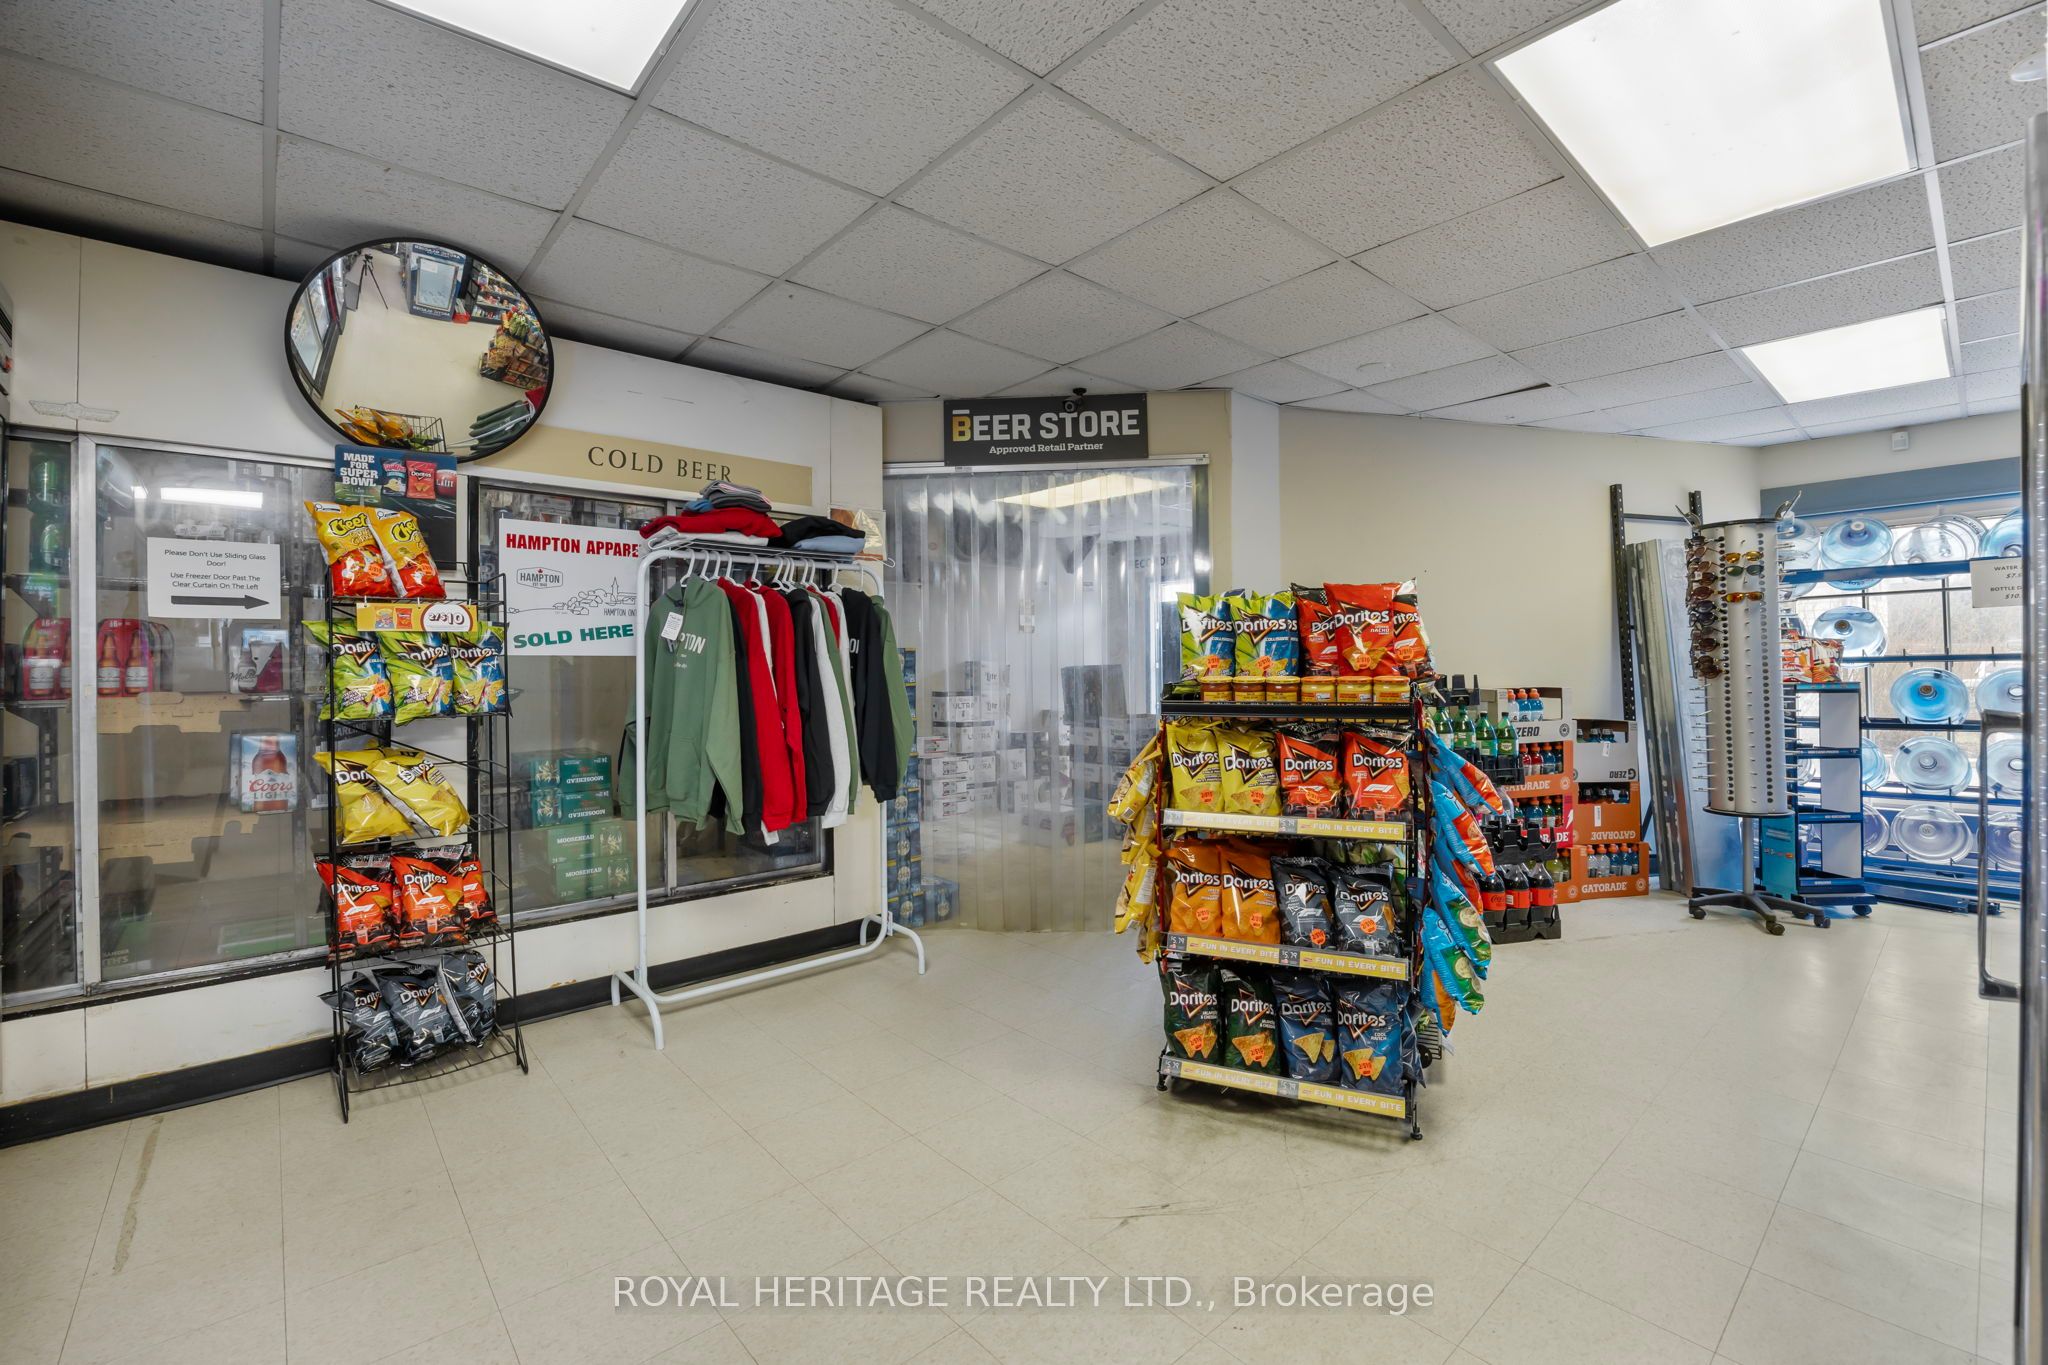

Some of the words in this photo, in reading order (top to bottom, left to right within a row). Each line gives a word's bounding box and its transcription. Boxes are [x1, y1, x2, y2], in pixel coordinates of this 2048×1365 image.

[952, 413, 1031, 441] BEER
[1039, 409, 1140, 439] STORE
[989, 444, 1036, 454] Approved
[1038, 442, 1066, 452] Retail
[1068, 442, 1104, 451] Partner
[343, 452, 375, 464] MADE
[588, 446, 663, 474] COLD
[677, 458, 732, 483] BEER
[350, 461, 369, 470] FOR
[340, 467, 378, 479] SUPER
[342, 476, 377, 487] BOWL
[328, 513, 368, 537] Cheet
[506, 533, 581, 554] HAMPTON
[586, 540, 641, 558] APPARE
[164, 549, 188, 557] Please
[189, 550, 208, 558] Don't
[224, 552, 247, 560] Sliding
[185, 572, 212, 580] Freezer
[519, 572, 560, 584] HAMPTON
[192, 581, 218, 589] Curtain
[604, 608, 627, 617] HAMPTON
[1334, 609, 1390, 628] Doritos
[1393, 612, 1420, 625] ritos
[428, 613, 465, 626] 2/$10
[1234, 618, 1287, 634] Doritos
[513, 630, 573, 649] SOLD
[580, 624, 634, 642] HERE
[1516, 726, 1540, 737] ZERO
[1173, 752, 1219, 767] Doritos
[1224, 756, 1274, 772] Doritos
[1285, 758, 1334, 771] Doritos
[1353, 753, 1403, 768] Doritos
[249, 779, 293, 793] Coors
[566, 775, 604, 784] MOOSEHEAD
[254, 791, 289, 800] LIGHT
[568, 810, 606, 819] MOOSEHEAD
[1312, 823, 1332, 831] FUN
[1346, 825, 1374, 833] EVERY
[1378, 827, 1399, 835] BITE
[557, 834, 595, 844] MOOSEHEAD
[1591, 831, 1636, 841] GATORADE
[404, 873, 448, 885] Doritos
[565, 867, 602, 878] MOOSEHEAD
[1223, 875, 1275, 891] Doritos
[1581, 882, 1628, 893] GATORADE
[1340, 891, 1389, 902] Doritos
[1230, 946, 1257, 956] EVERY
[1260, 950, 1279, 959] BITE
[1336, 959, 1345, 967] IN
[1348, 960, 1377, 971] EVERY
[1380, 964, 1401, 974] BITE
[1169, 991, 1217, 1006] Doritos
[1231, 998, 1275, 1015] Doritos
[1281, 1002, 1332, 1016] Doritos
[1338, 1010, 1386, 1027] Doritos
[1314, 1090, 1332, 1099] FUN
[1335, 1093, 1344, 1101] IN
[1347, 1095, 1376, 1106] EVERY
[1380, 1101, 1401, 1112] BITE
